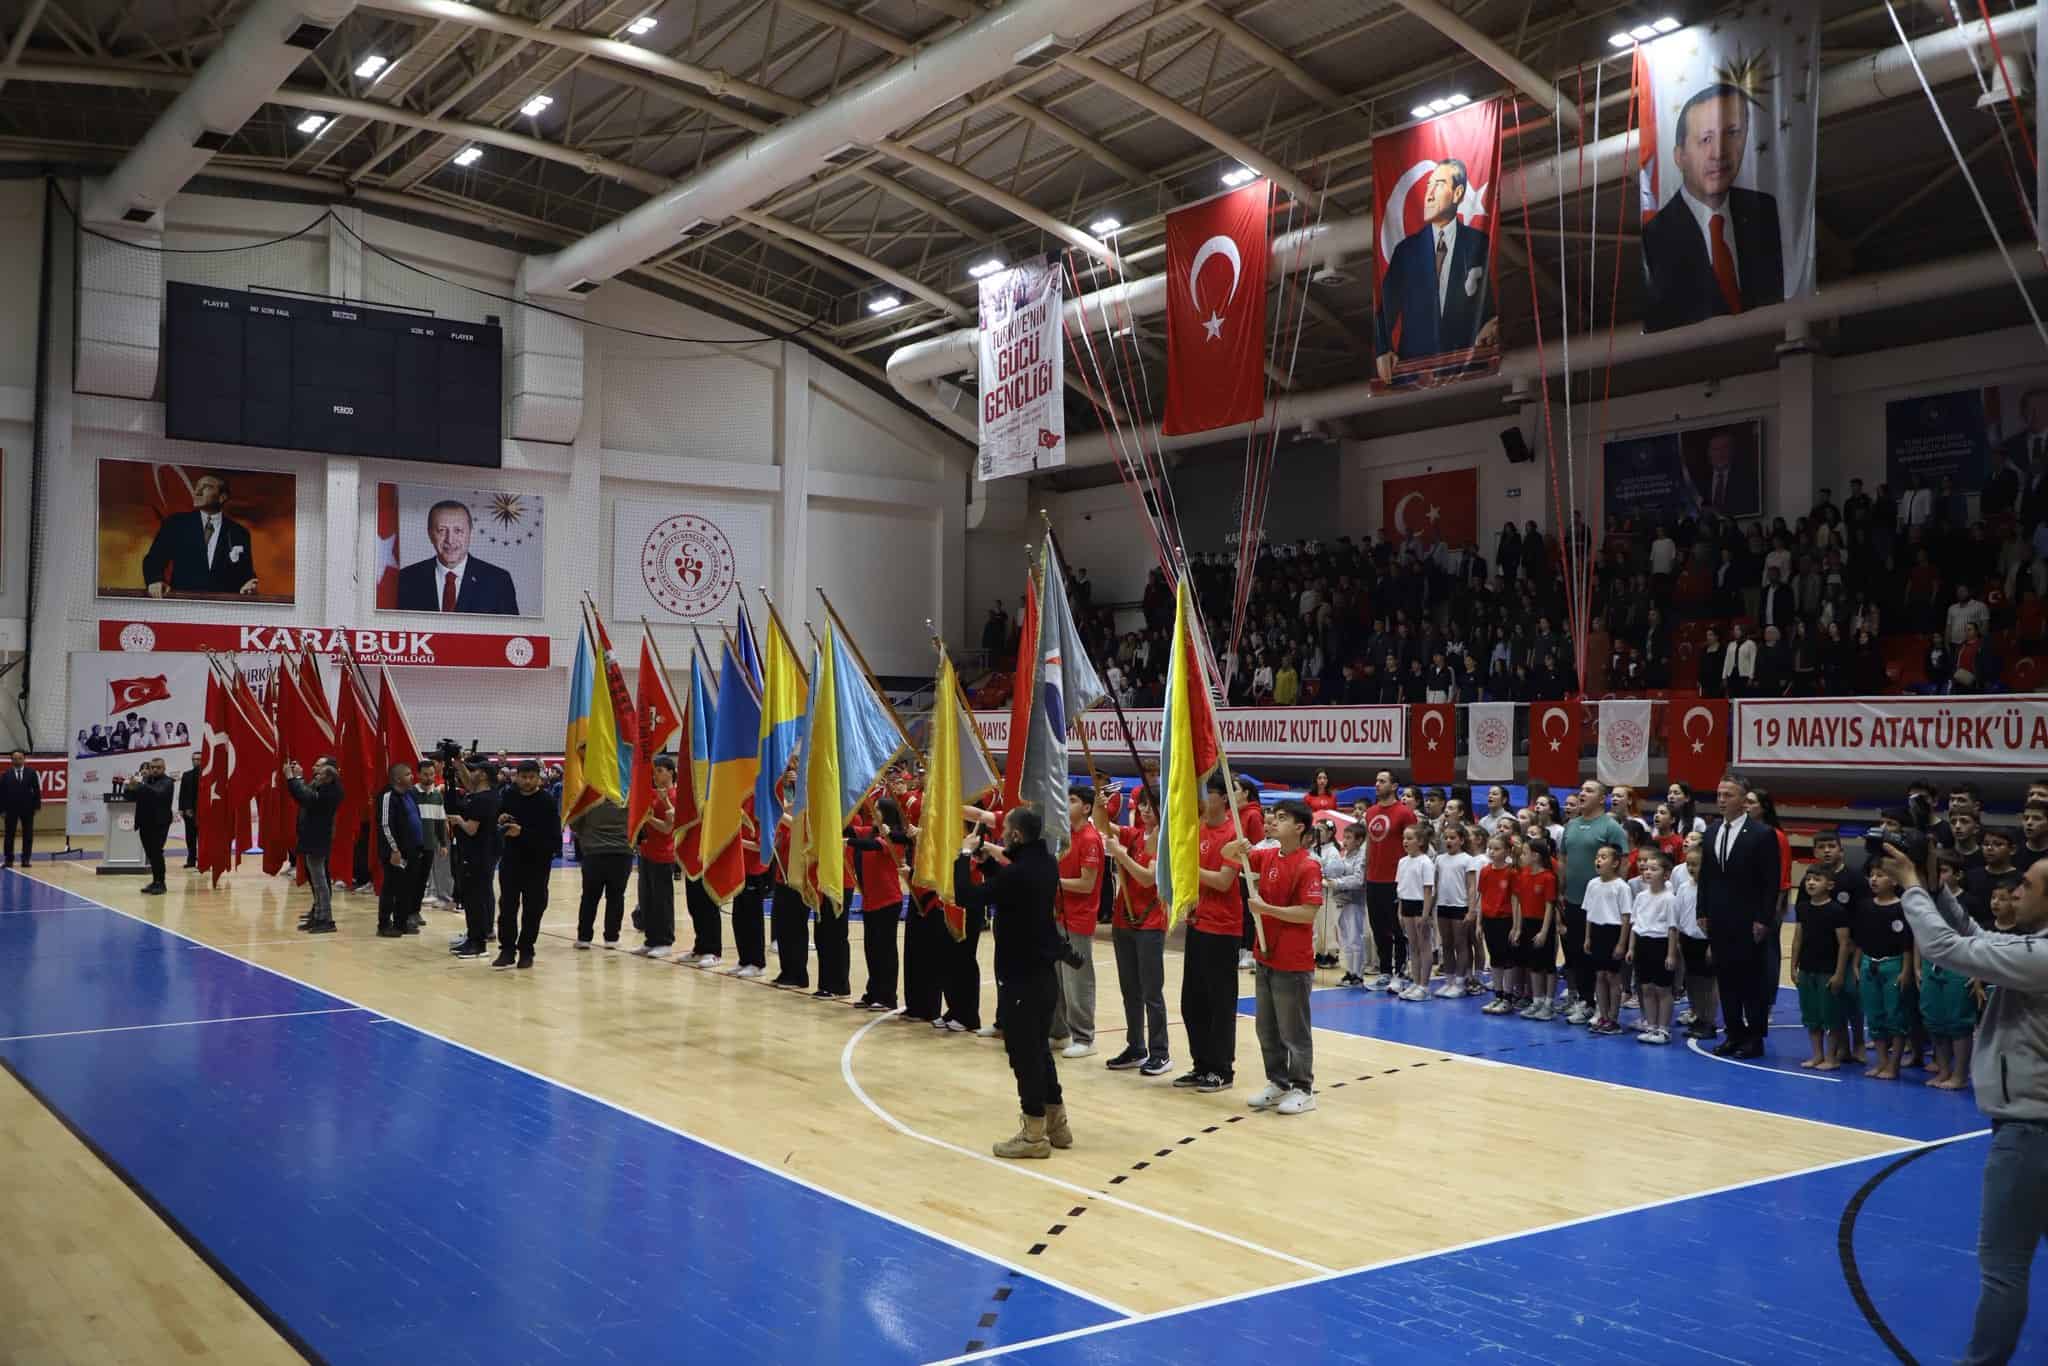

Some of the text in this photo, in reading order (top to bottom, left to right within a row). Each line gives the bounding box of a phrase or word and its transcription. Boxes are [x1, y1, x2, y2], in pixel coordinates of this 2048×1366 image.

[998, 331, 1040, 382] GÜCÜ
[985, 360, 1053, 424] GENÇLİĞİ
[240, 626, 434, 655] KARABÜK
[1219, 719, 1287, 742] YRAMIMIZ
[1290, 719, 1337, 743] KUTLU
[1340, 719, 1393, 743] OLSUN
[1753, 718, 1781, 747] 19
[1787, 717, 1864, 747] MAYIS
[1870, 709, 2024, 749] ATATÜRK'Ü
[35, 770, 66, 791] YIS
